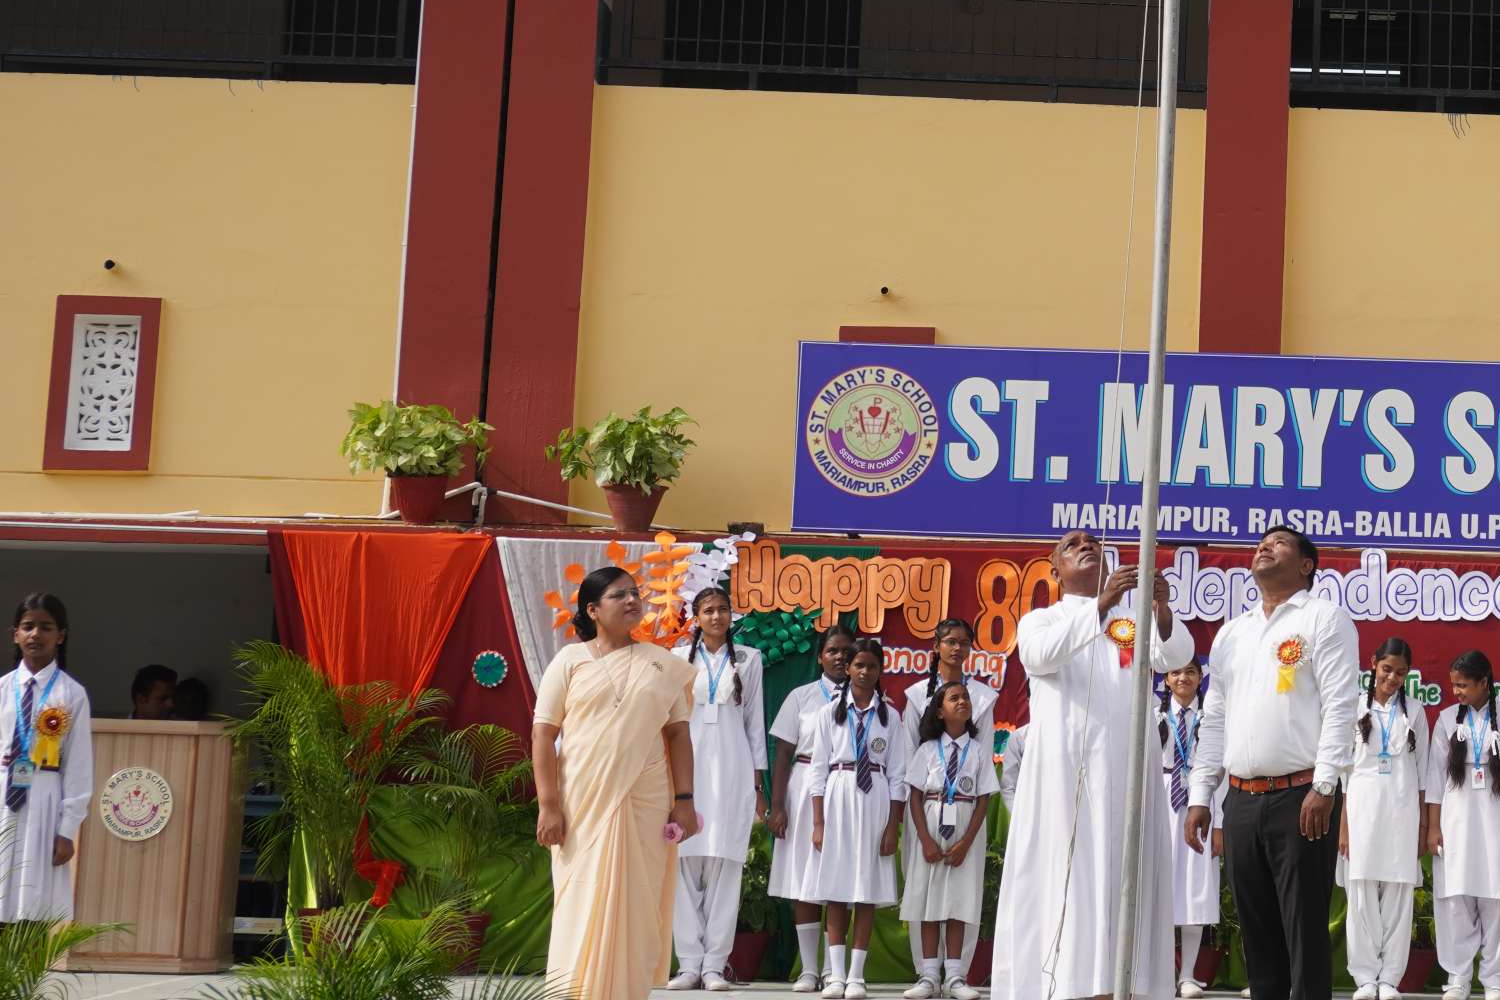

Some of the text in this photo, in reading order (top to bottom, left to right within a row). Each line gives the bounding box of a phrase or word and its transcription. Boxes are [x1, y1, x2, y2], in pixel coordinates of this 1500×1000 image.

[809, 369, 938, 437] ST. MARY'S SCHOOL
[945, 376, 1069, 482] ST.
[1097, 381, 1415, 492] MARY'S
[814, 449, 929, 493] MARIAMPUR, RASRA
[839, 449, 866, 470] SERVICE
[876, 449, 905, 470] CHARITY
[1052, 503, 1238, 536] MARIAMPUR,
[1247, 507, 1451, 539] RASRA-BALLIA
[732, 539, 952, 639] Happy
[1404, 670, 1441, 706] The
[145, 772, 171, 806] SCHOOL
